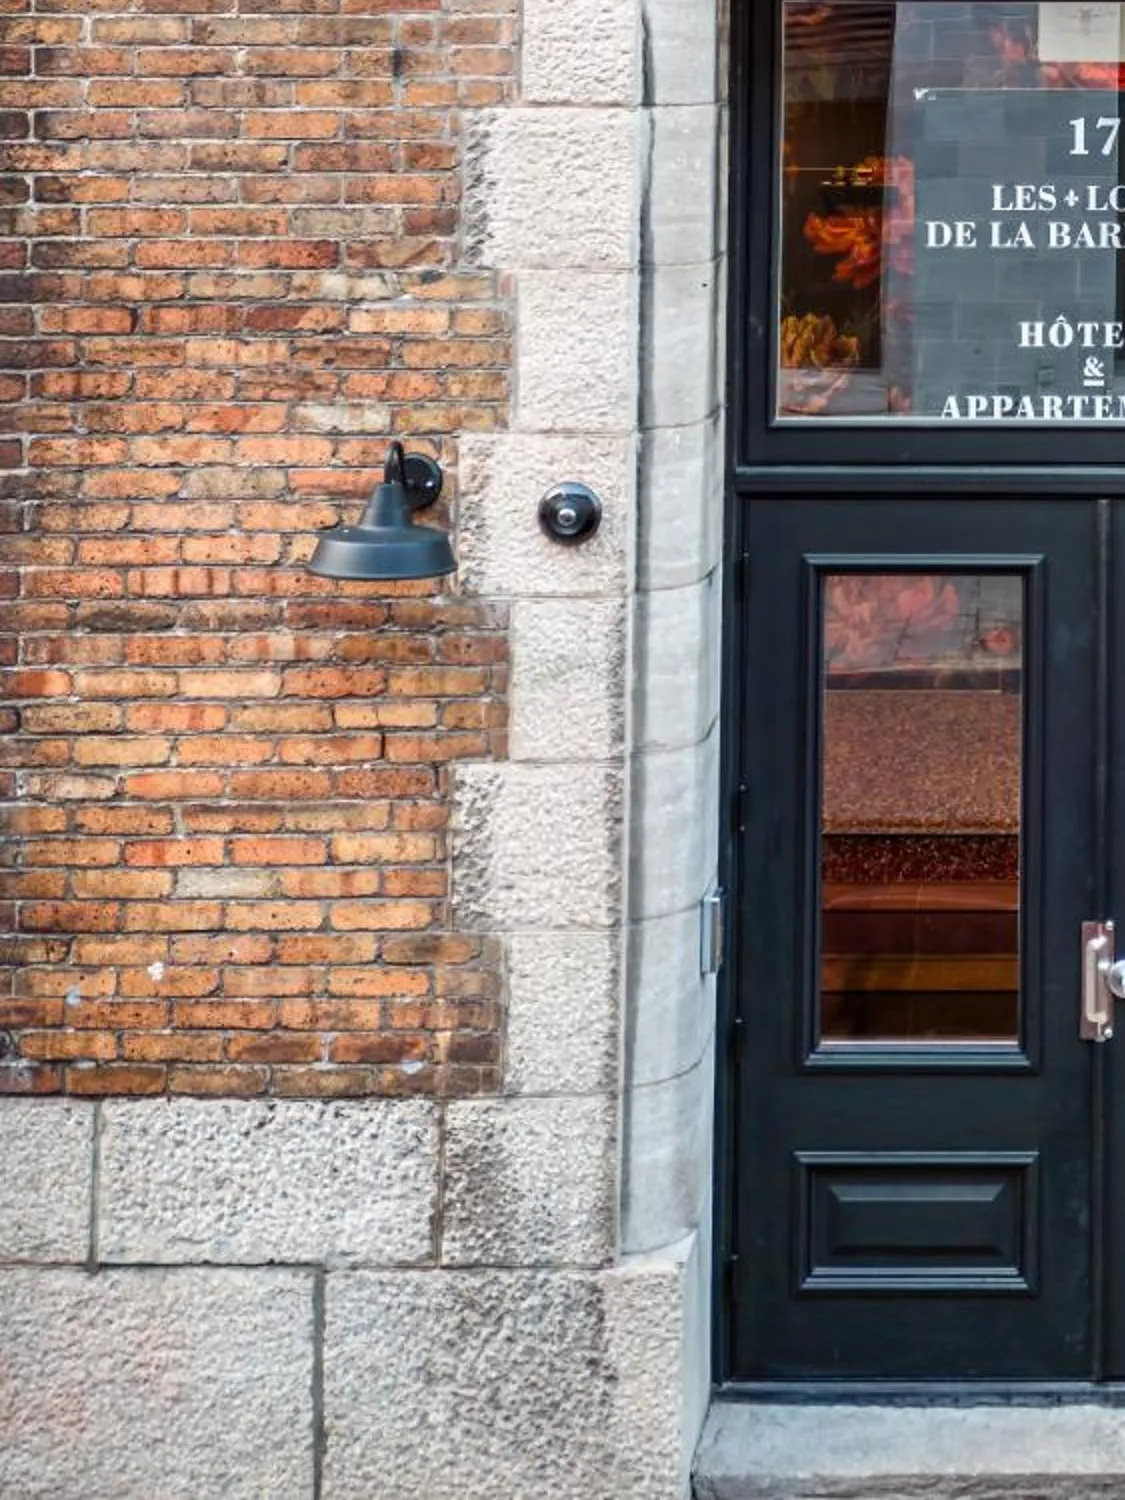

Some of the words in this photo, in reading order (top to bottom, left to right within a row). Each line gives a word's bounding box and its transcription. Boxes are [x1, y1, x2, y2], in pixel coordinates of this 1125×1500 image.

[1070, 117, 1121, 156] 17
[991, 185, 1057, 212] LES
[926, 222, 977, 248] DE
[990, 222, 1034, 248] LA
[1083, 357, 1105, 380] &
